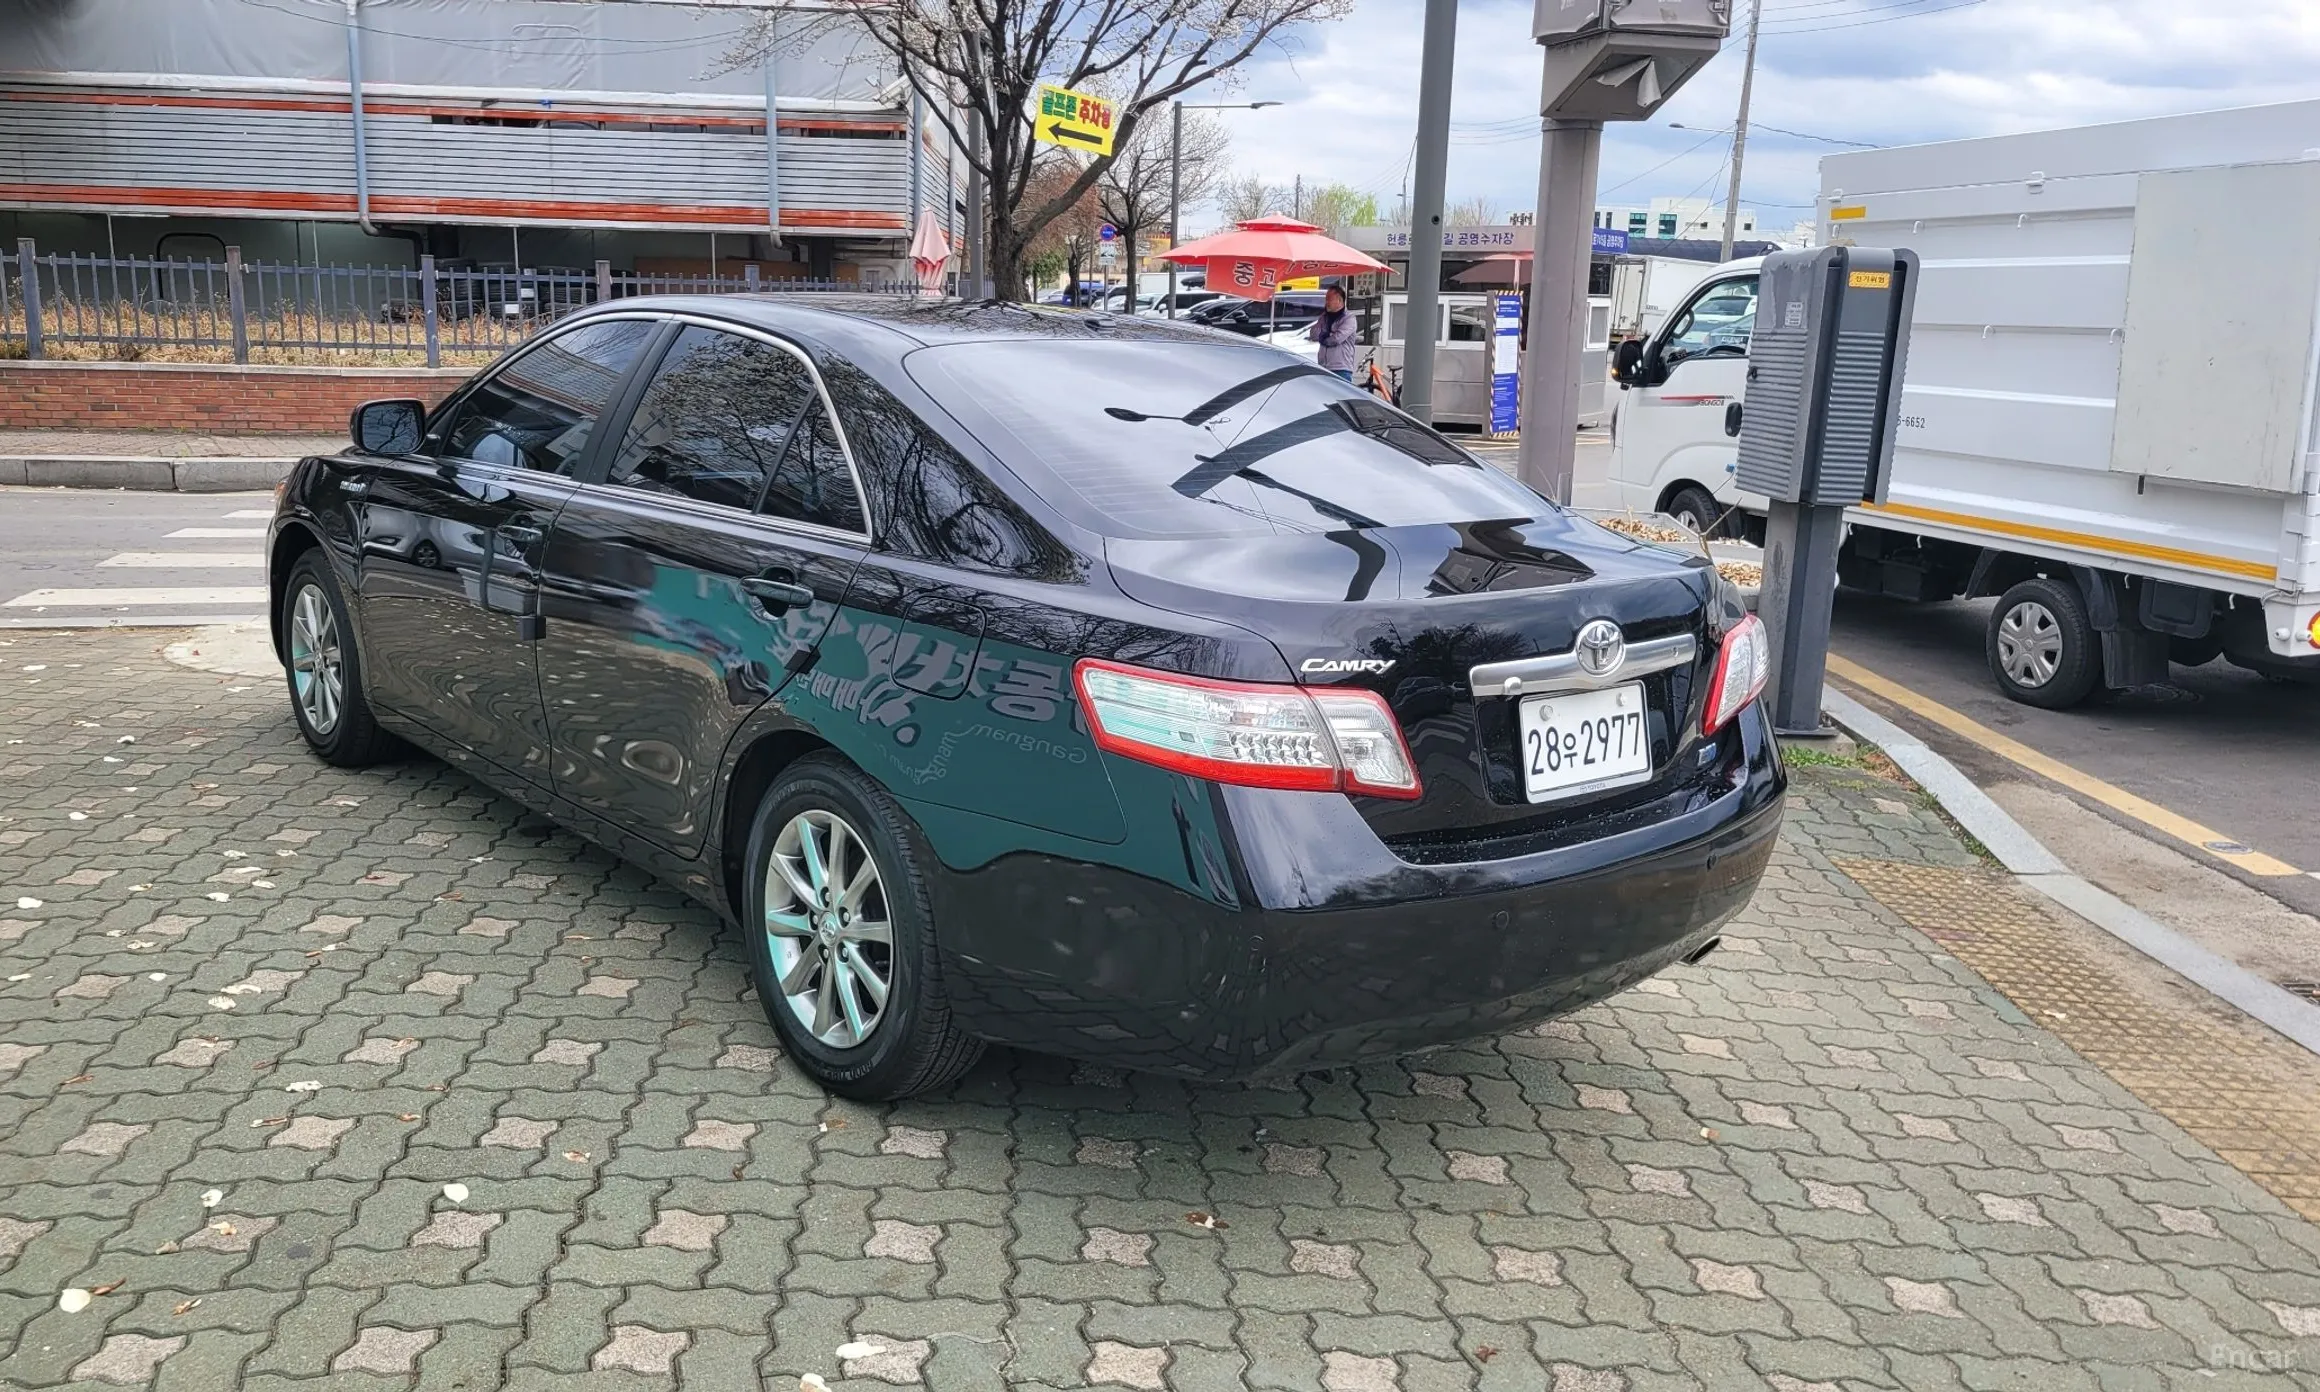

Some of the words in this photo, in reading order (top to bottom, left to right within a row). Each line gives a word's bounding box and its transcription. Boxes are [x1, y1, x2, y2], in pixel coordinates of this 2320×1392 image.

[1079, 98, 1111, 130] 주차장
[1301, 658, 1396, 674] CAMRY
[1528, 712, 1640, 776] 28우2977
